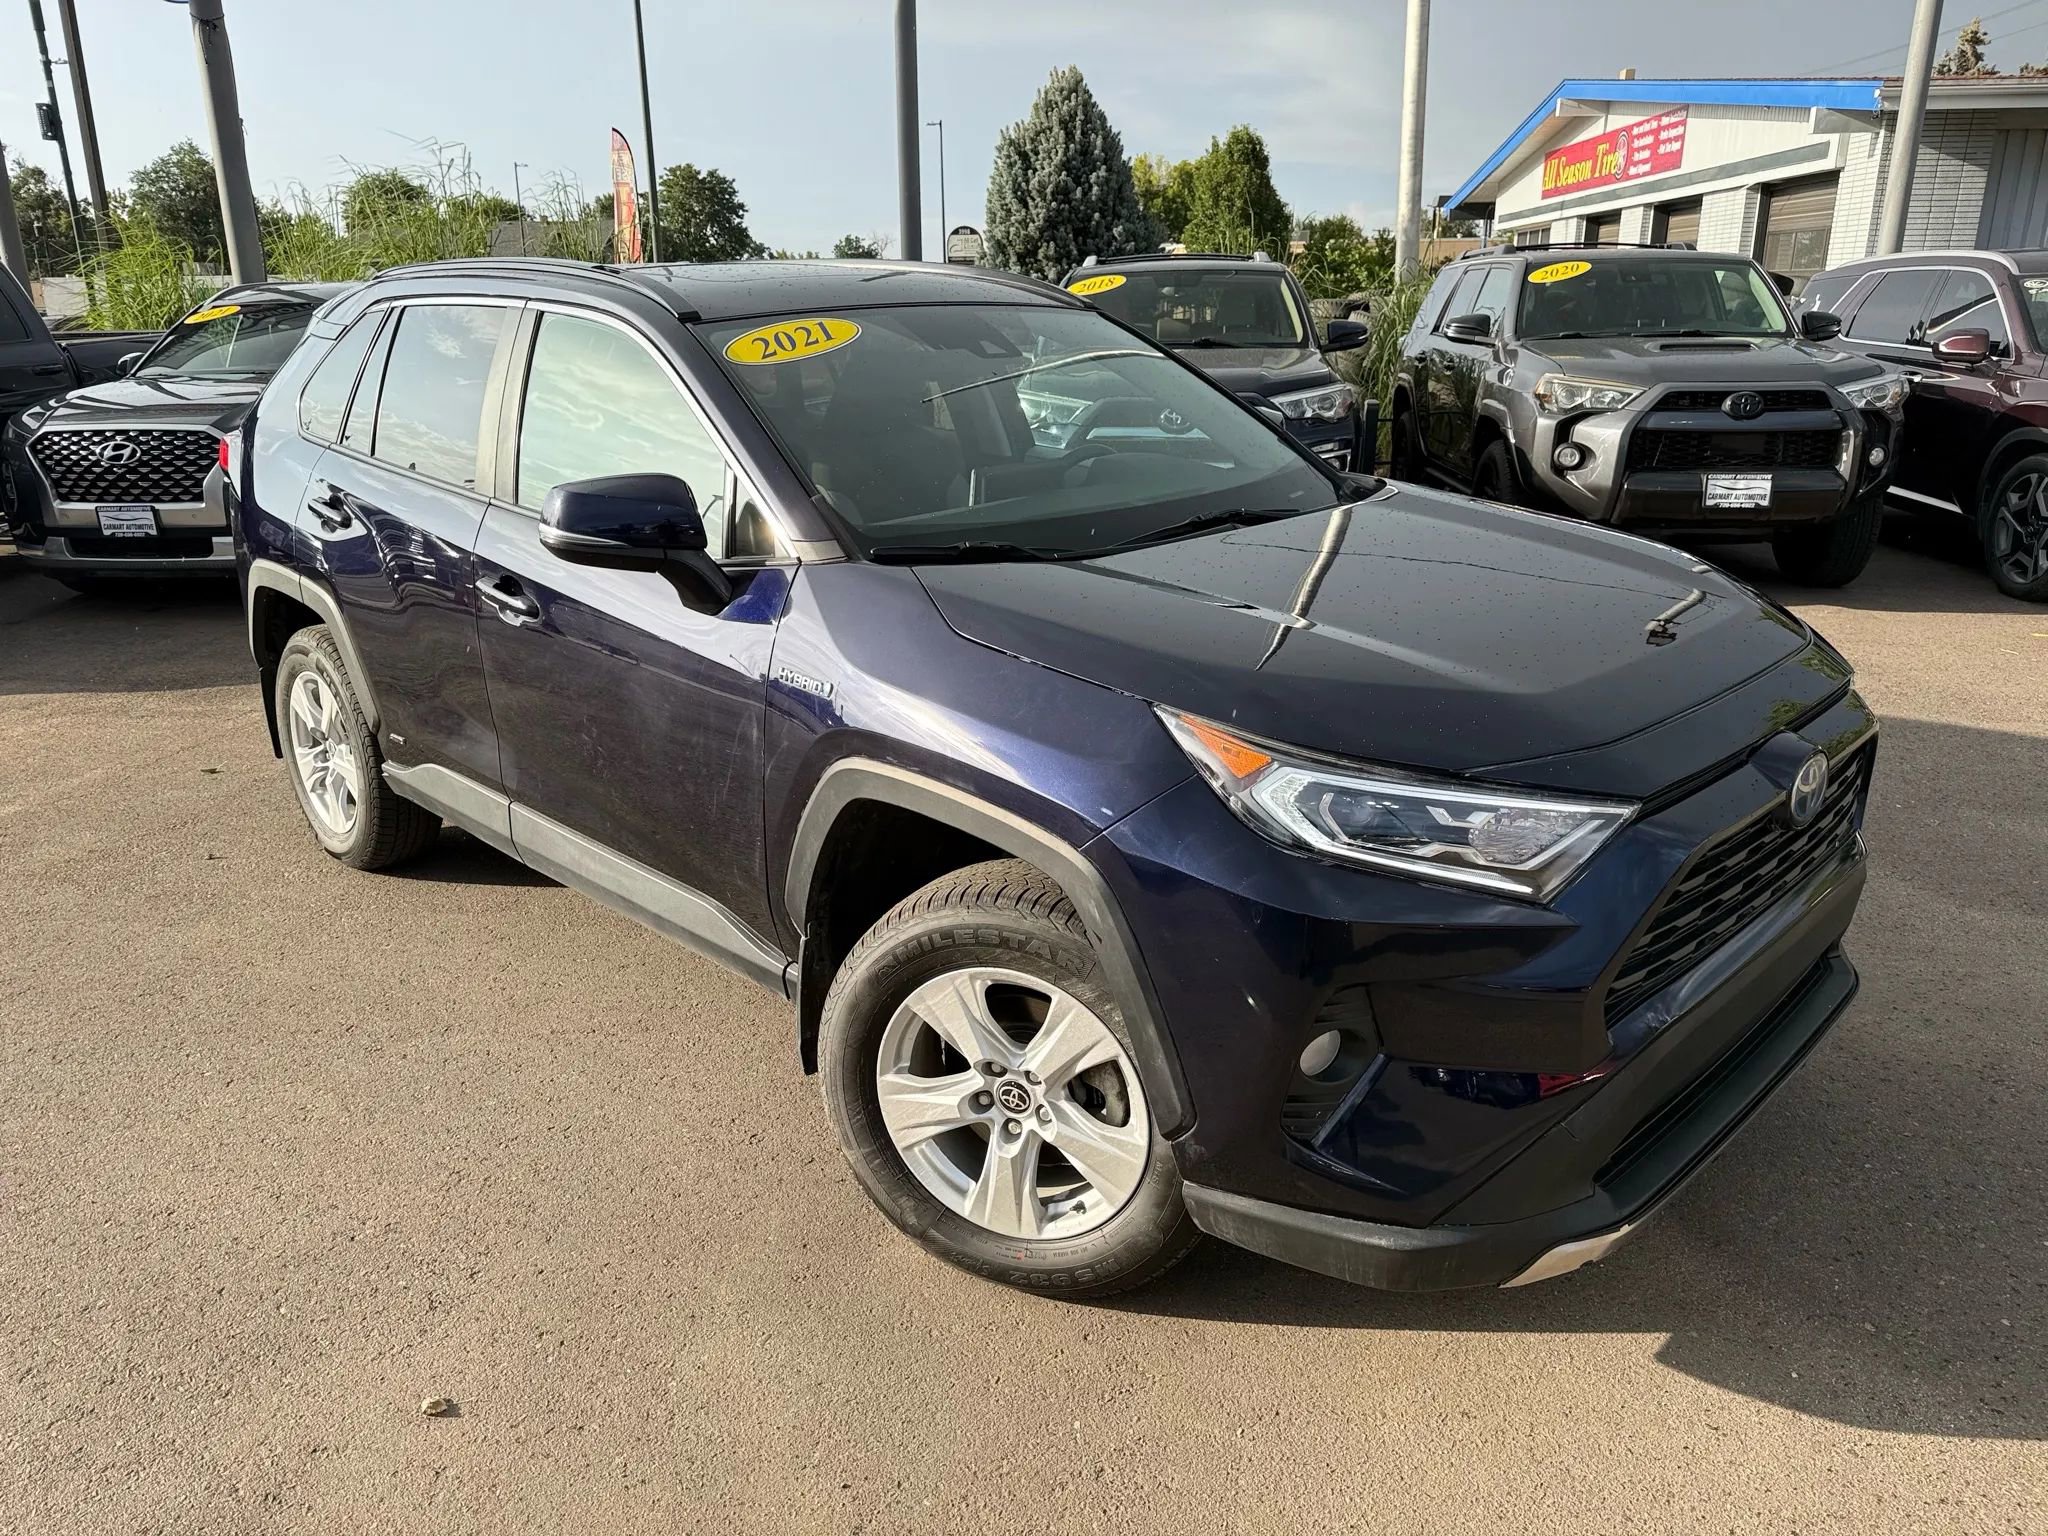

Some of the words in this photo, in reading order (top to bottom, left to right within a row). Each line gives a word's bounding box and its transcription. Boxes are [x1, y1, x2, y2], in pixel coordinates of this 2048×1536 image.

[1543, 158, 1559, 191] All
[1557, 156, 1593, 187] Season
[1594, 143, 1620, 177] Tire
[1541, 263, 1580, 280] 2020
[1077, 277, 1116, 293] 2018
[751, 321, 837, 360] 2021
[1734, 493, 1768, 501] AUTOMOTIVE
[126, 523, 154, 531] AUTOMOTIVE
[779, 667, 822, 696] HYBRID
[896, 928, 1088, 979] MILESTAR
